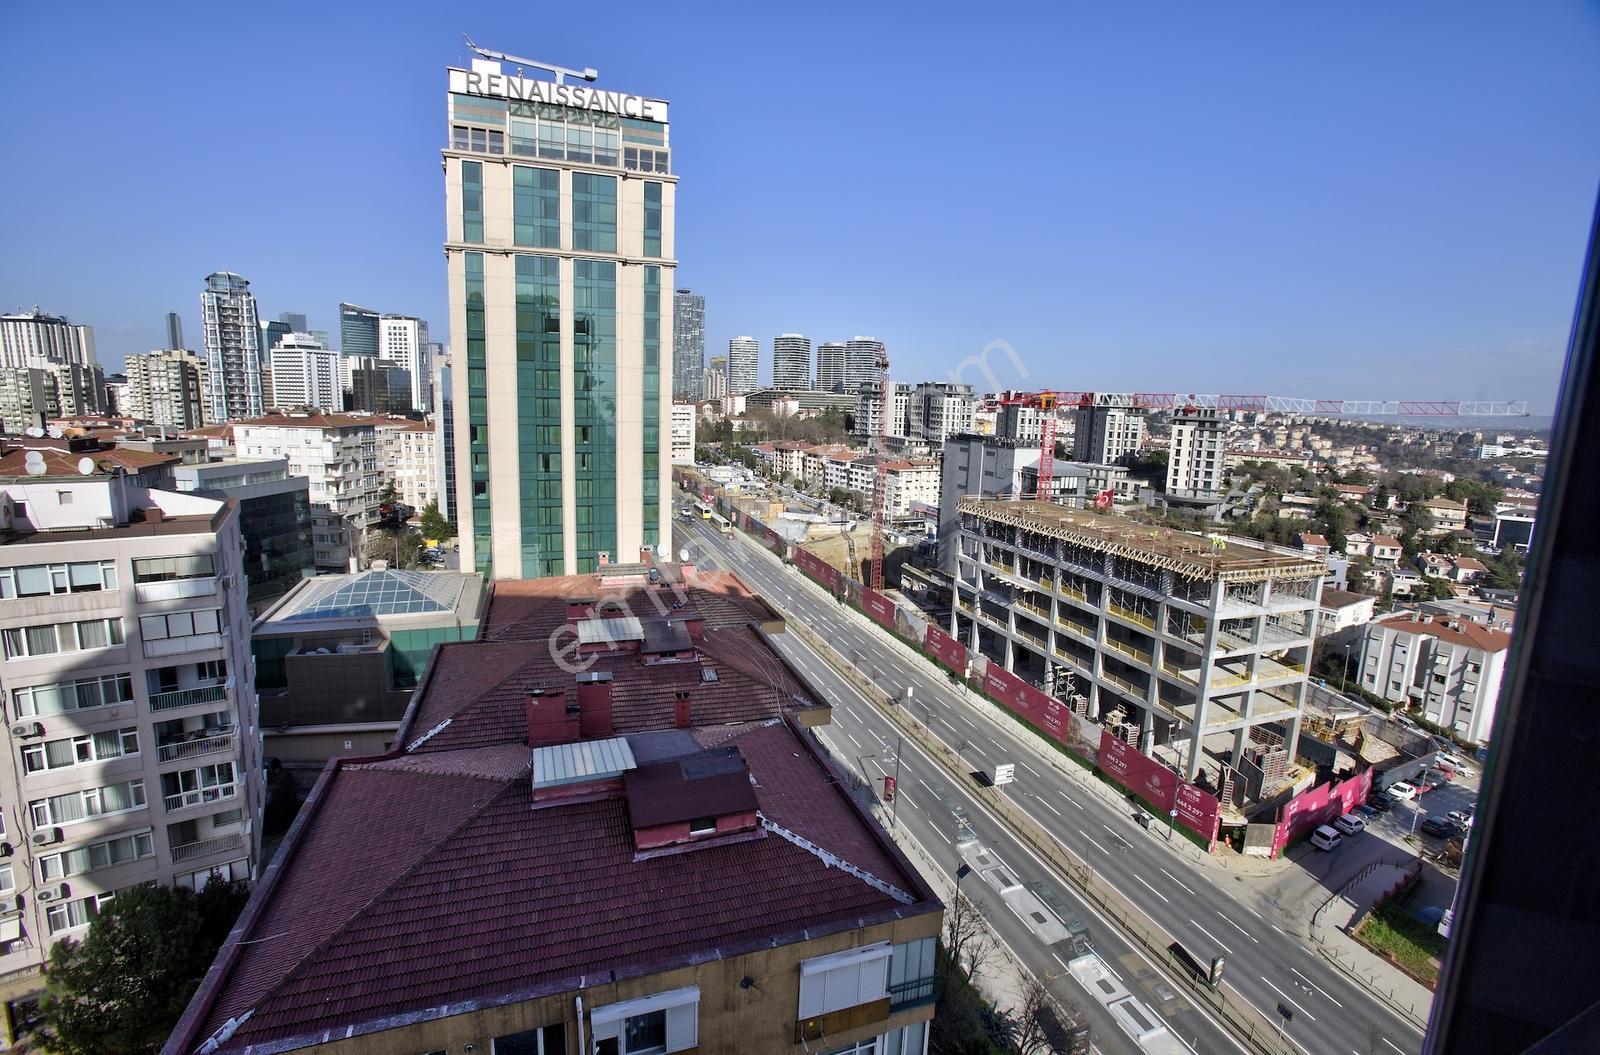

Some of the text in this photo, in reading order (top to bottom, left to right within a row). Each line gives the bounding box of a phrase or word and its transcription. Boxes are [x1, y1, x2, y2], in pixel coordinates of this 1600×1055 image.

[466, 71, 655, 120] RENAISSANCE
[1176, 798, 1187, 809] 444
[1192, 807, 1204, 817] 297
